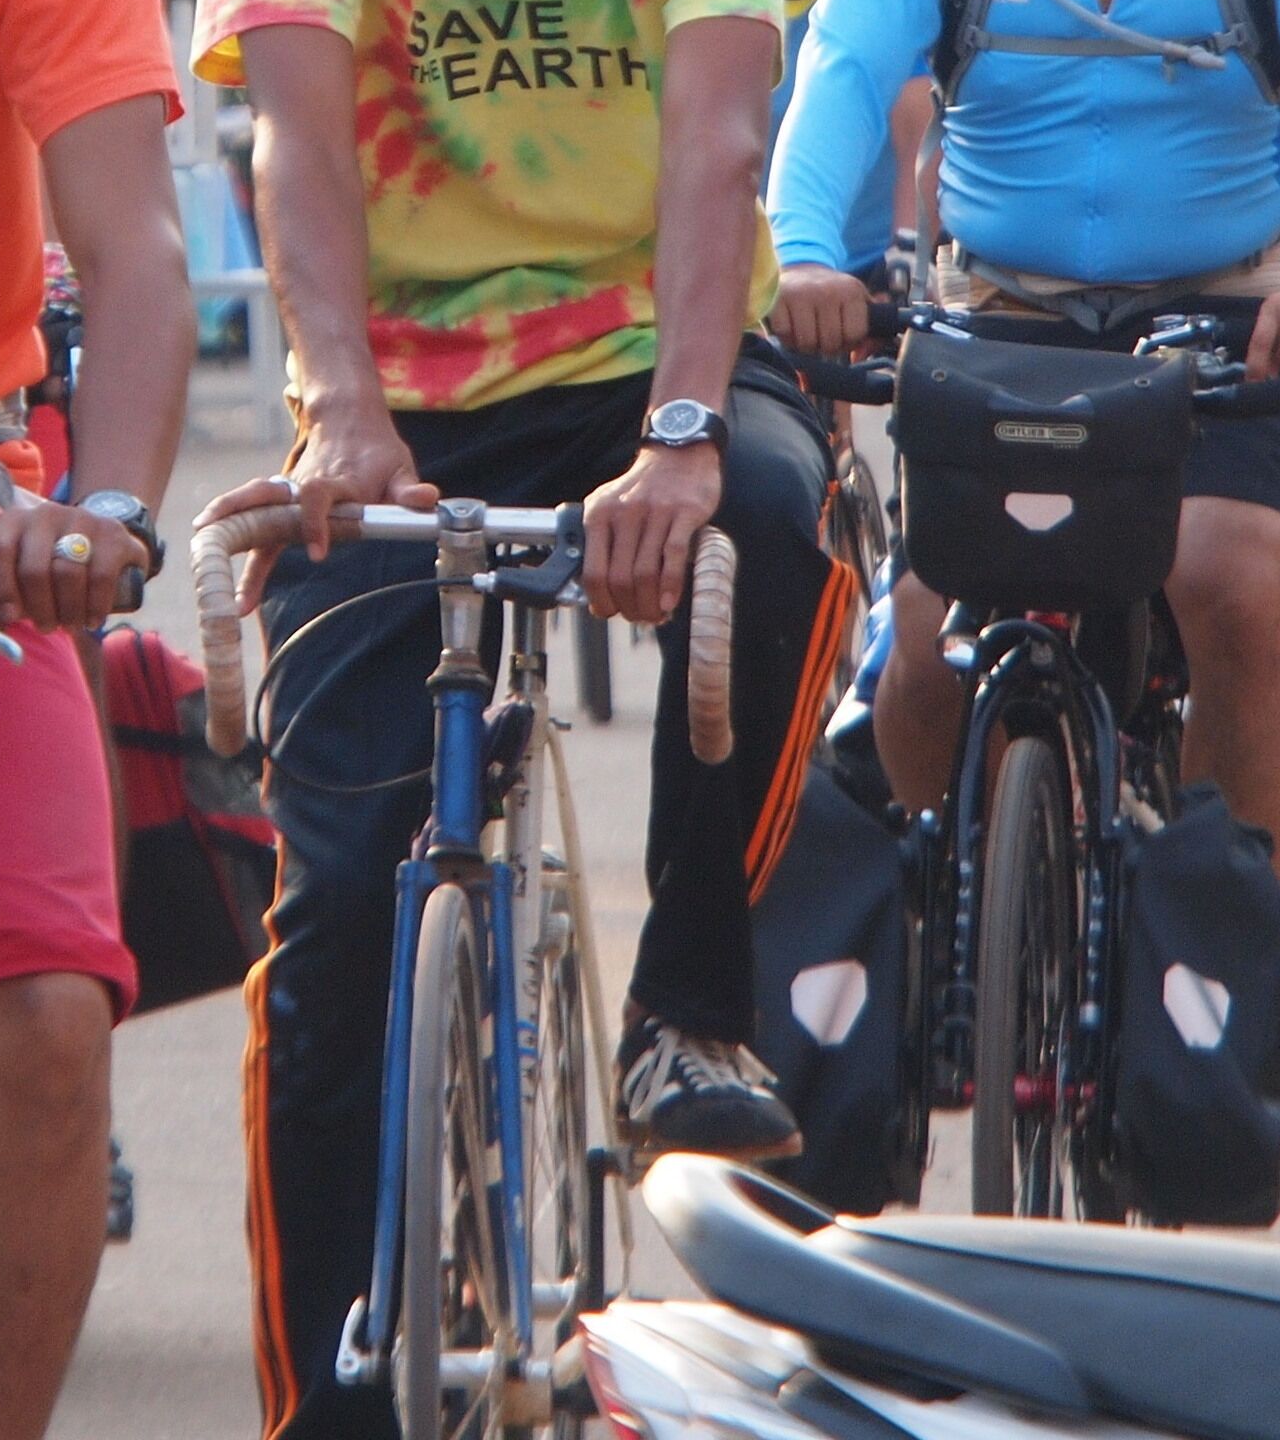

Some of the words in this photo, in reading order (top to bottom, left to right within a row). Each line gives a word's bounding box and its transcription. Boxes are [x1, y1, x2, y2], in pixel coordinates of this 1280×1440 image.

[407, 0, 569, 57] SAVE
[408, 59, 441, 84] THE
[440, 46, 651, 101] EARTH
